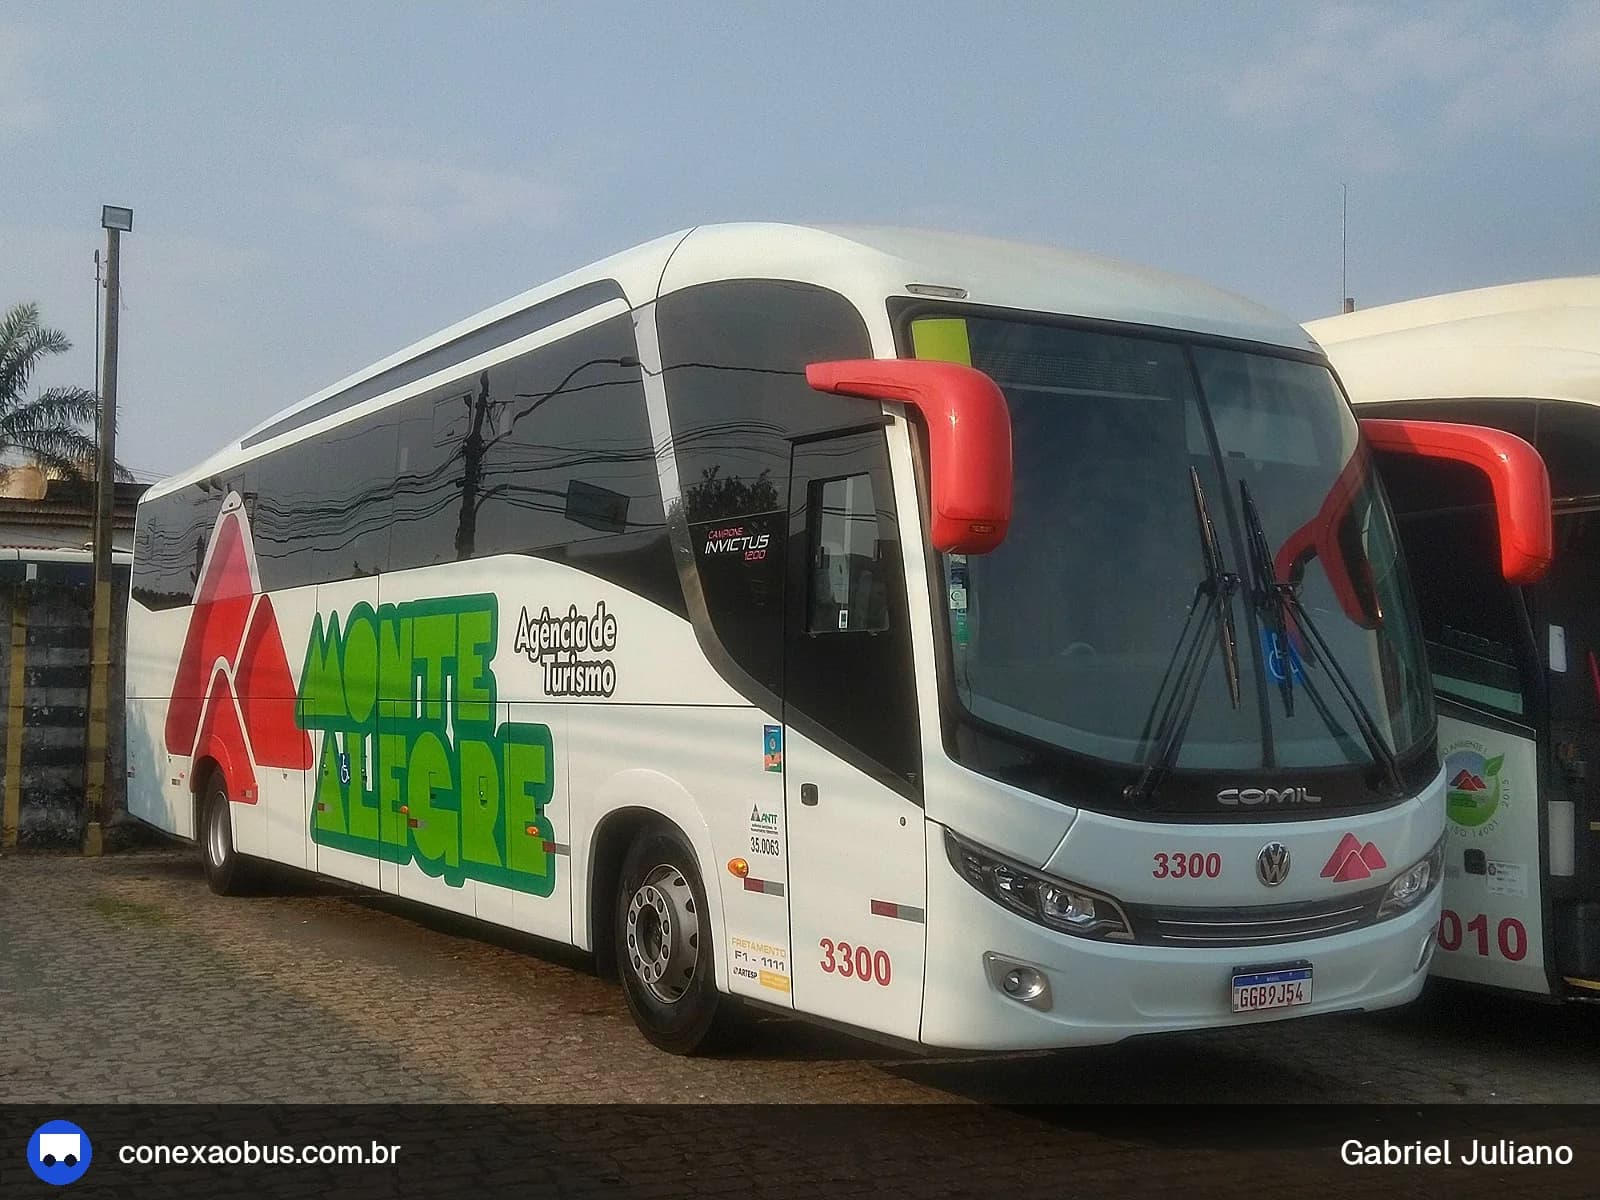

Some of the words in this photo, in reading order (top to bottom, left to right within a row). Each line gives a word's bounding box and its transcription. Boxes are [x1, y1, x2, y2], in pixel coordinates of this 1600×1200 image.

[704, 534, 771, 555] INVICTUS
[744, 549, 767, 561] 1200
[514, 605, 588, 662] Agência
[589, 600, 617, 652] de
[296, 598, 496, 725] MONTE
[540, 651, 616, 698] Turismo
[1216, 787, 1322, 805] COMIL
[312, 730, 553, 888] ALEGRE
[761, 812, 778, 825] ANTT
[750, 836, 780, 856] 35.0063
[1152, 852, 1222, 880] 3300
[731, 936, 787, 959] FRETAMENTO
[734, 949, 749, 962] F1
[760, 956, 786, 972] 1111
[818, 937, 892, 987] 3300
[738, 967, 758, 979] ARTESP
[1240, 982, 1304, 1008] GGB9J54
